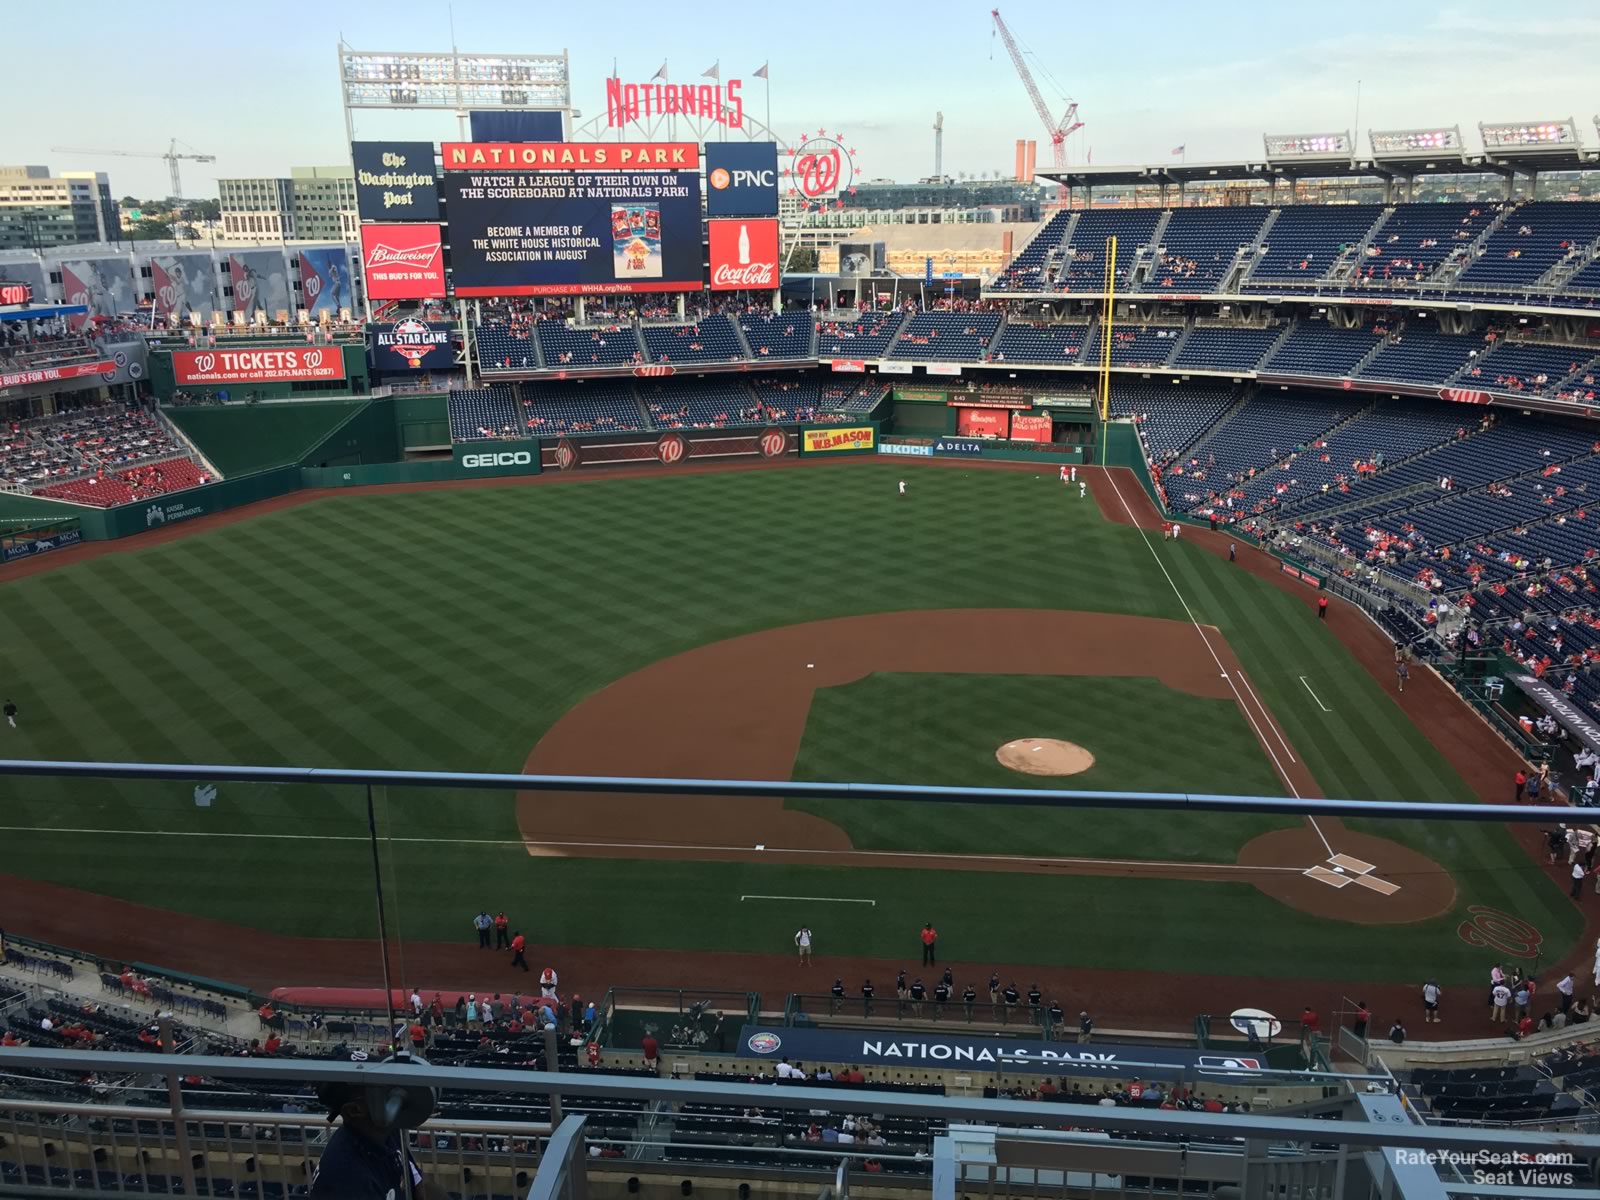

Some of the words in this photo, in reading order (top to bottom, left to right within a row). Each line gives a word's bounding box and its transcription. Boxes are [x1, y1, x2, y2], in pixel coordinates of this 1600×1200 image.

[606, 77, 743, 129] NATIONALS
[382, 152, 406, 168] The
[452, 148, 608, 163] NATIONALS
[621, 148, 686, 163] PARK
[358, 169, 434, 189] Washington
[470, 176, 515, 187] WATCH
[518, 177, 527, 187] A
[529, 176, 575, 186] LEAGUE
[577, 176, 592, 186] OF
[594, 176, 629, 186] THEIR
[632, 176, 659, 186] OWN
[661, 176, 678, 186] ON
[732, 169, 775, 187] PNC
[460, 188, 485, 199] THE
[487, 187, 566, 198] SCOREBOARD
[568, 187, 584, 198] AT
[587, 187, 652, 198] NATIONALS
[654, 186, 689, 197] PARK!
[384, 191, 414, 208] Post
[487, 226, 523, 237] BECOME
[525, 226, 532, 236] A
[533, 226, 570, 236] MEMBER
[572, 225, 583, 236] OF
[472, 239, 489, 250] THE
[491, 239, 520, 249] WHITE
[521, 238, 549, 248] HOUSE
[551, 237, 601, 248] HISTORICAL
[371, 249, 434, 263] Budweiser
[486, 251, 542, 262] ASSOCIATION
[543, 251, 551, 260] IN
[552, 250, 588, 260] AUGUST
[372, 272, 388, 281] THIS
[388, 272, 409, 280] BUD'S
[409, 272, 423, 280] FOR
[423, 272, 440, 280] YOU.
[713, 261, 776, 286] Coca-Cola
[534, 286, 569, 294] PURCHASE
[581, 284, 633, 294] WHHA.org/Nats
[378, 332, 396, 346] ALL
[396, 332, 421, 346] STAR
[422, 332, 448, 345] GAME
[220, 351, 298, 370] TICKETS
[4, 373, 27, 385] BUD'S
[28, 371, 43, 382] FOR
[44, 369, 61, 380] YOU.
[187, 372, 239, 381] nationals.com
[239, 371, 248, 379] or
[249, 370, 263, 379] call
[893, 444, 929, 456] KOCH
[946, 443, 980, 452] DELTA
[461, 451, 531, 468] GEICO
[166, 503, 185, 514] KAISER
[59, 531, 80, 543] MGM
[7, 544, 29, 556] MGM
[862, 1040, 1030, 1064] NATIONALS
[1130, 1088, 1140, 1097] 20
